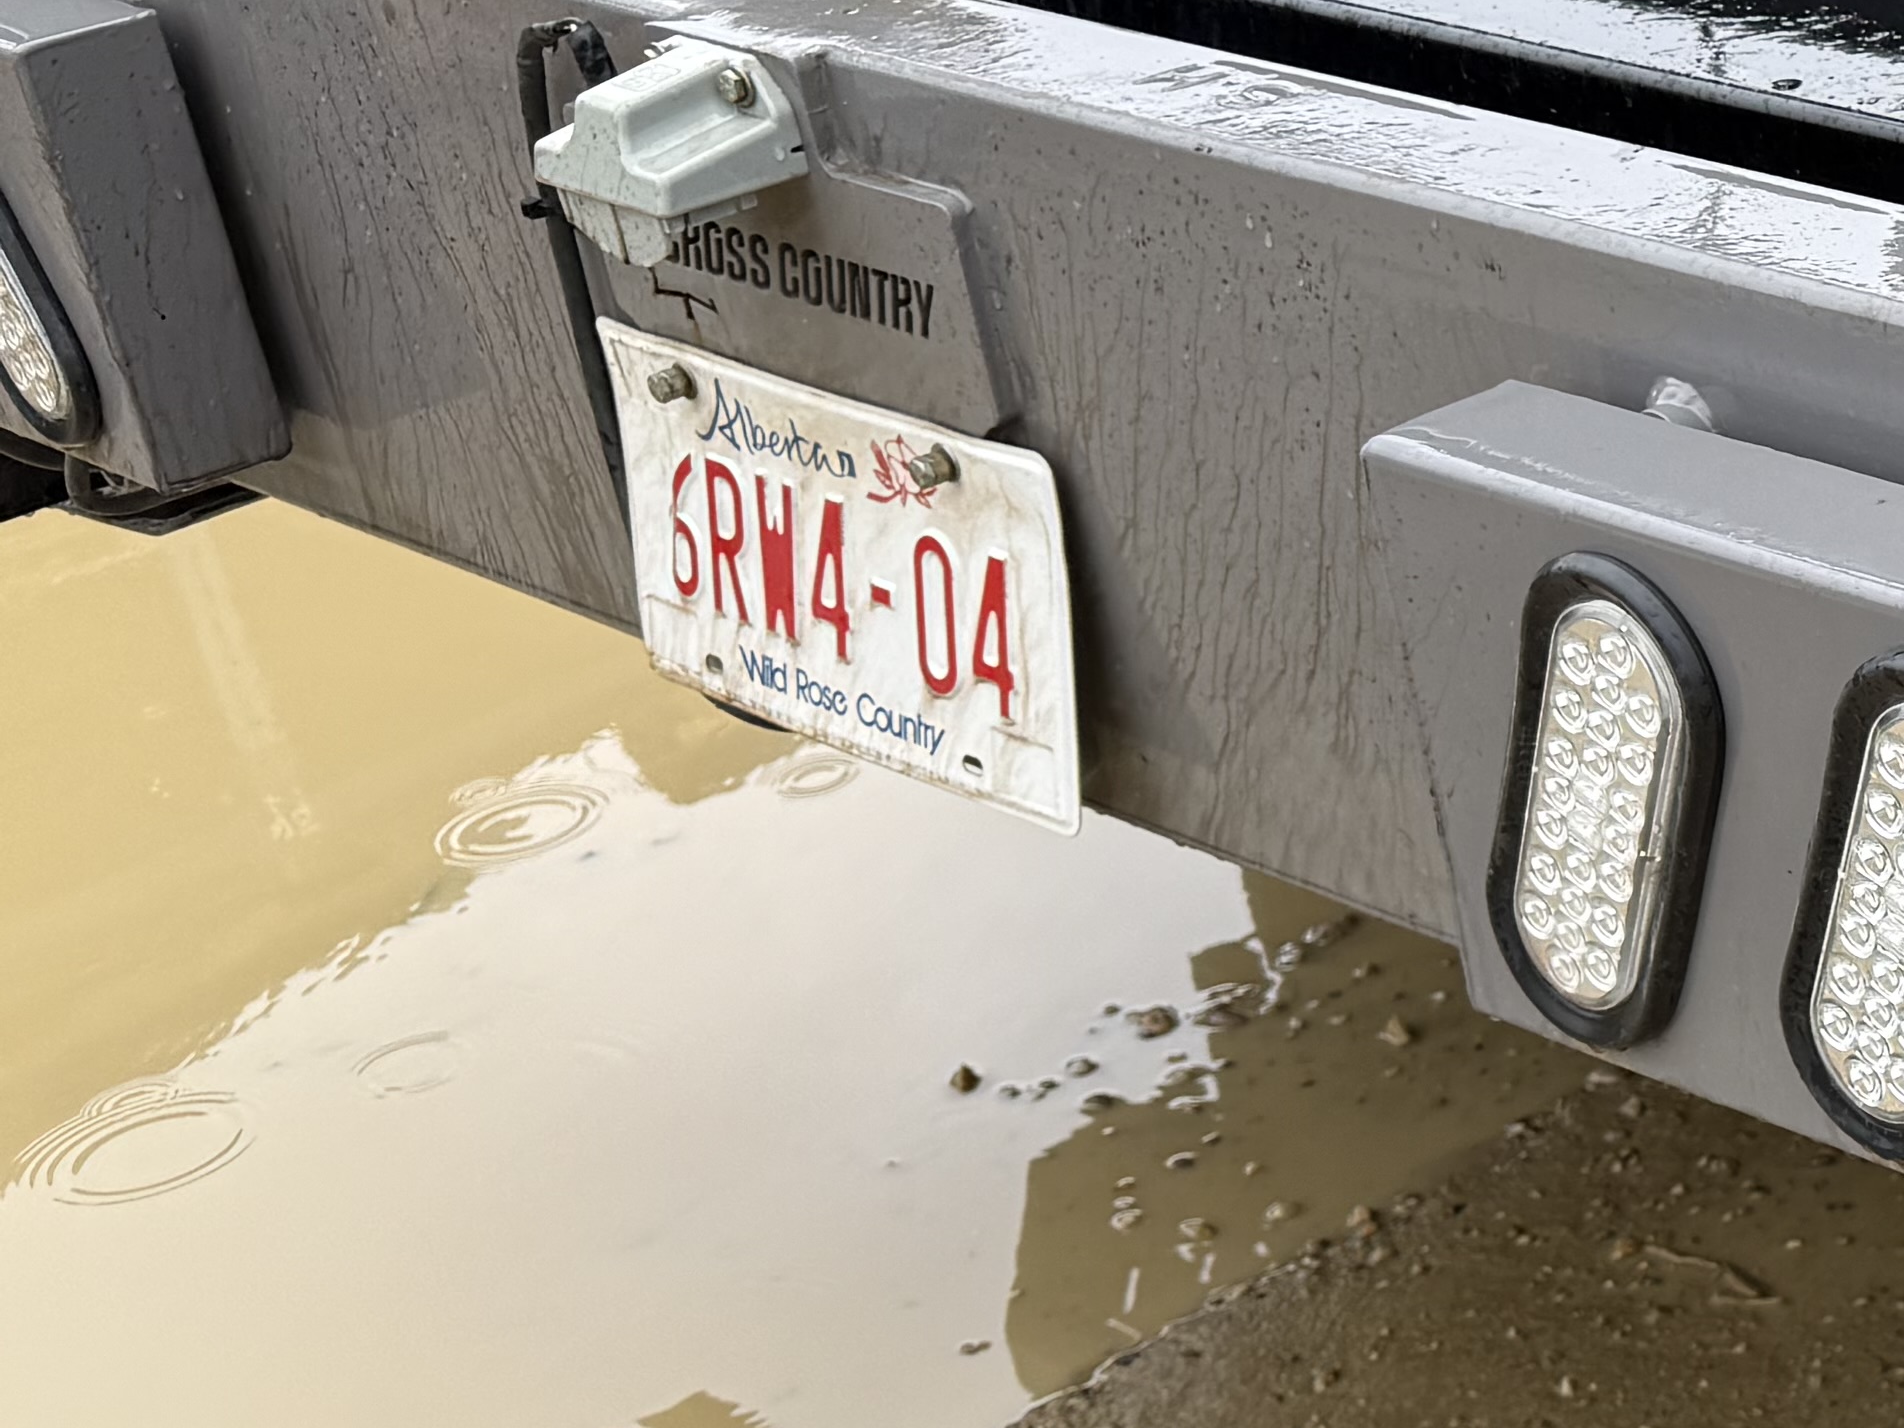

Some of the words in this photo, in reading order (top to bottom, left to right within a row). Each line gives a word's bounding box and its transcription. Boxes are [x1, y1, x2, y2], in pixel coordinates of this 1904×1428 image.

[666, 218, 771, 291] ROSS
[779, 242, 934, 340] COUNTRY
[696, 377, 856, 479] Alberta
[671, 452, 1015, 725] 6RW4-04
[738, 644, 788, 694] Wild
[795, 671, 848, 716] Rose
[856, 692, 946, 756] Country
